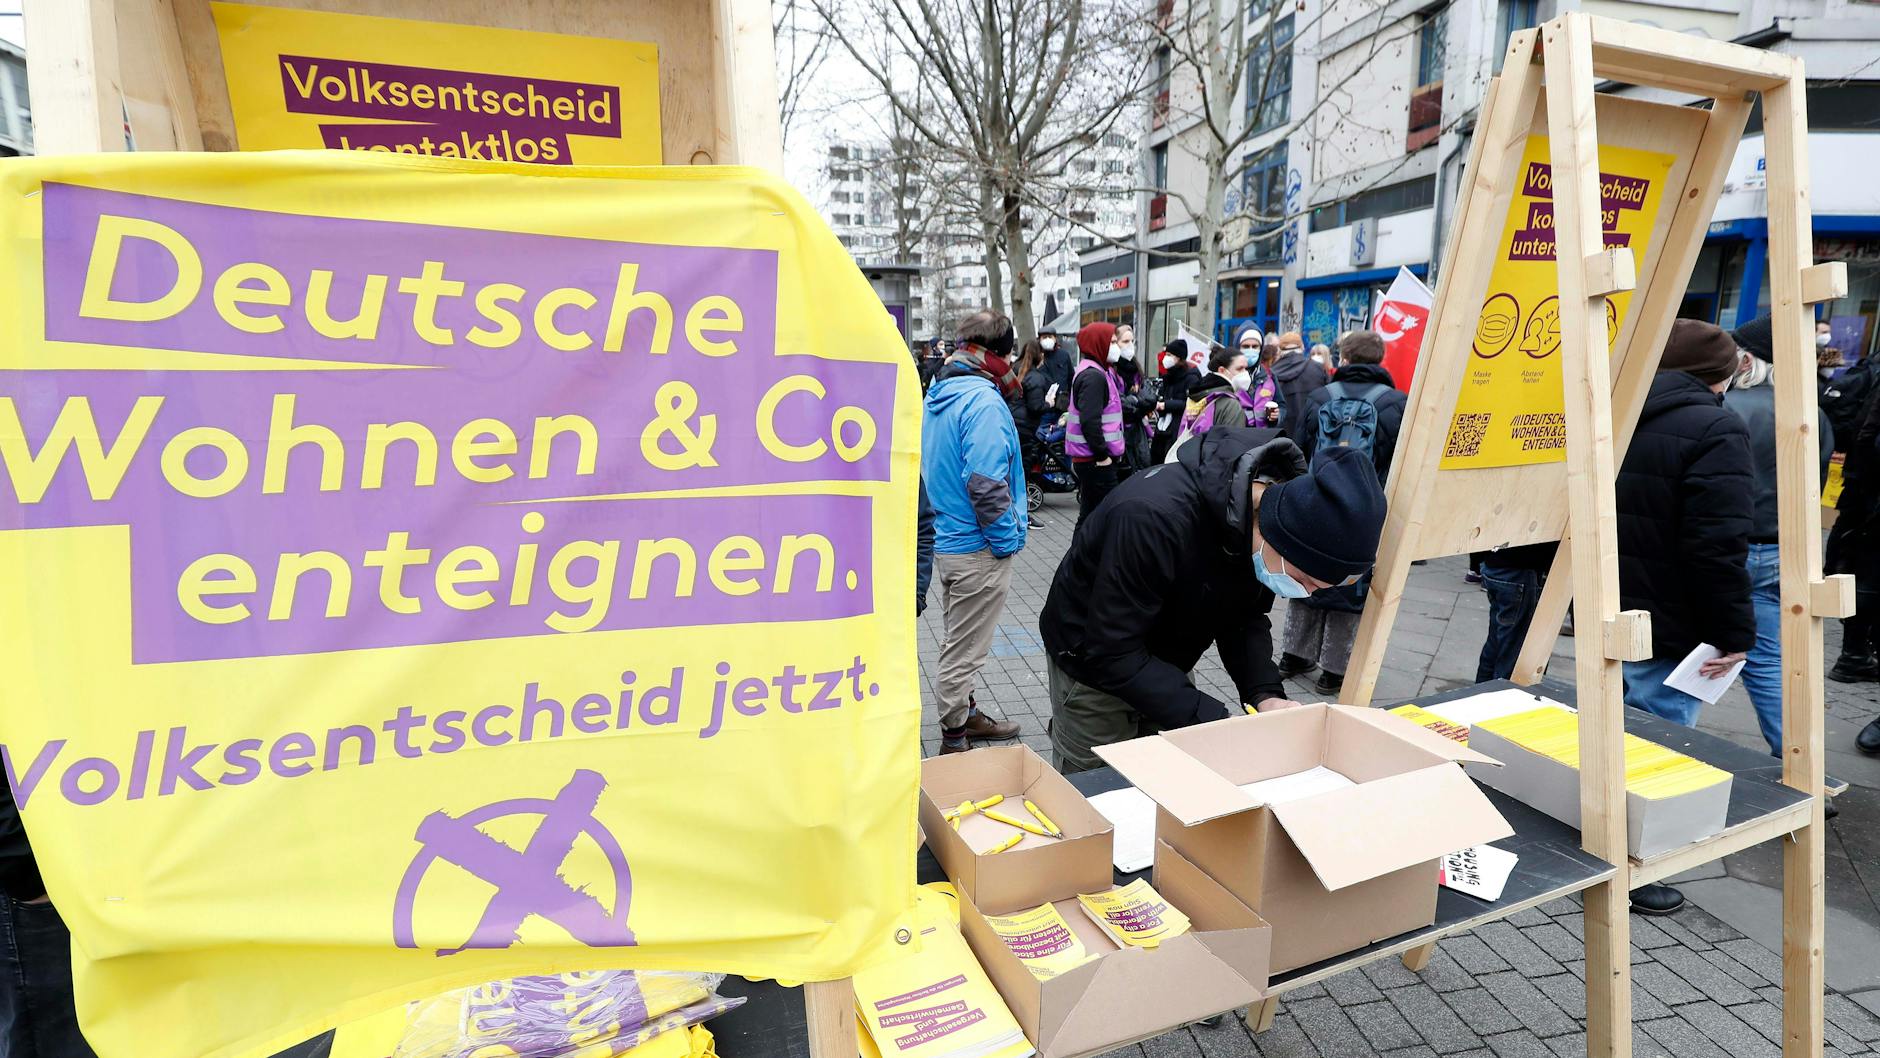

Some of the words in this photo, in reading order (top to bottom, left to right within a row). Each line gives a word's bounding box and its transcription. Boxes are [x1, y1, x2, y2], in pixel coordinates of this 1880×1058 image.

[283, 61, 613, 124] Volksentscheid
[340, 130, 560, 162] taktlos
[80, 214, 745, 357] Deutsche
[0, 394, 598, 504] Wohnen
[640, 381, 720, 471] &
[756, 374, 877, 463] Co
[177, 512, 860, 634] enteignen.
[0, 667, 685, 811] Volksentscheid
[700, 655, 880, 738] jetzt.
[1124, 899, 1142, 908] Sign
[1135, 903, 1151, 913] rent
[1121, 909, 1133, 918] for
[1148, 904, 1164, 918] with
[1147, 918, 1161, 928] For
[1020, 934, 1033, 943] für
[1033, 925, 1061, 939] Mieten
[1054, 930, 1068, 941] mit
[1037, 946, 1056, 956] eine
[1056, 939, 1072, 951] Für
[881, 1003, 965, 1026] Gemeinwirtschaft
[897, 1012, 983, 1047] Vergesellschaftung
[917, 1019, 935, 1032] und
